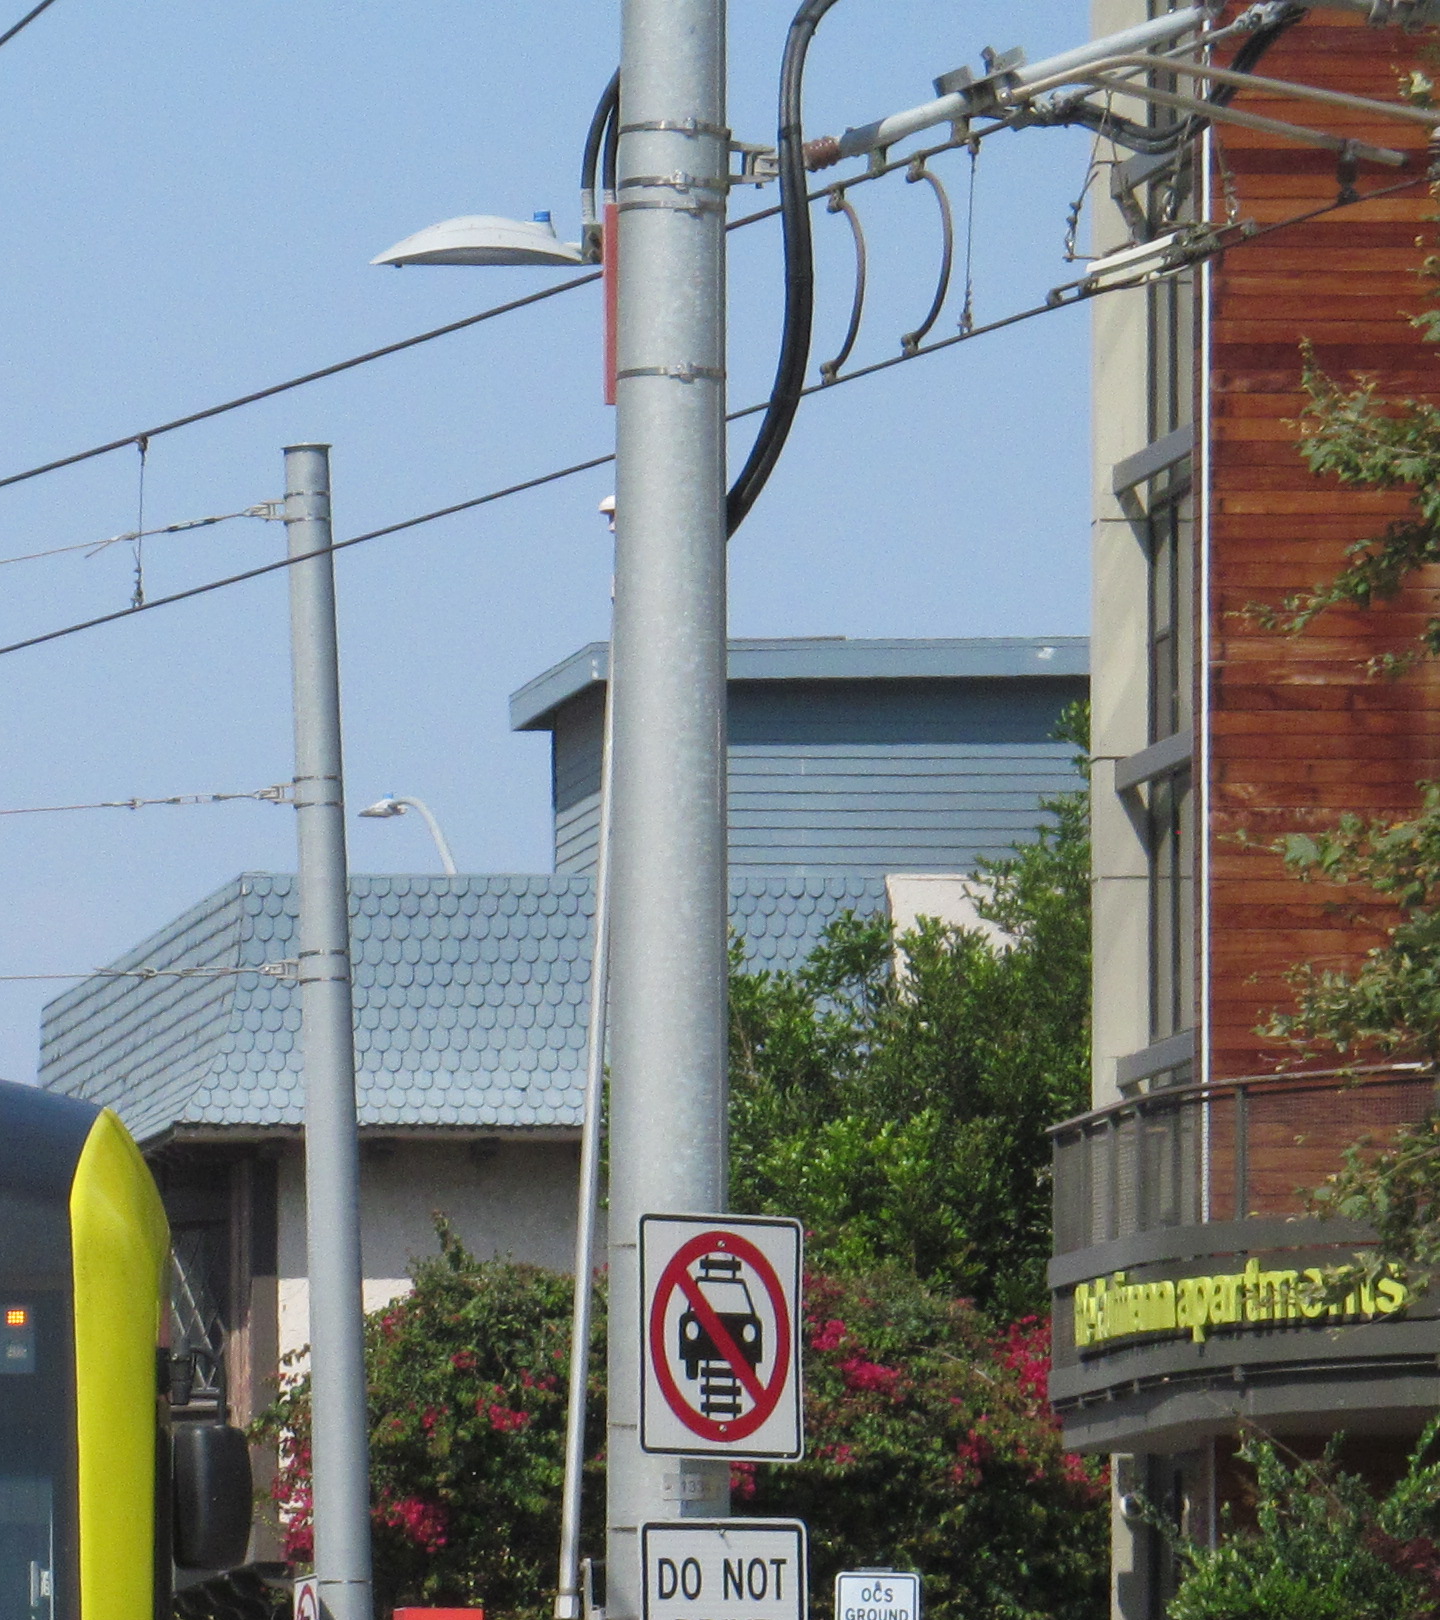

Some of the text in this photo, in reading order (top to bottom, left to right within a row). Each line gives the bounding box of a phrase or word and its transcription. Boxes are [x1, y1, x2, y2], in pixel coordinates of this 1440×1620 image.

[658, 1557, 787, 1600] DO NOT
[861, 1587, 894, 1603] OCS
